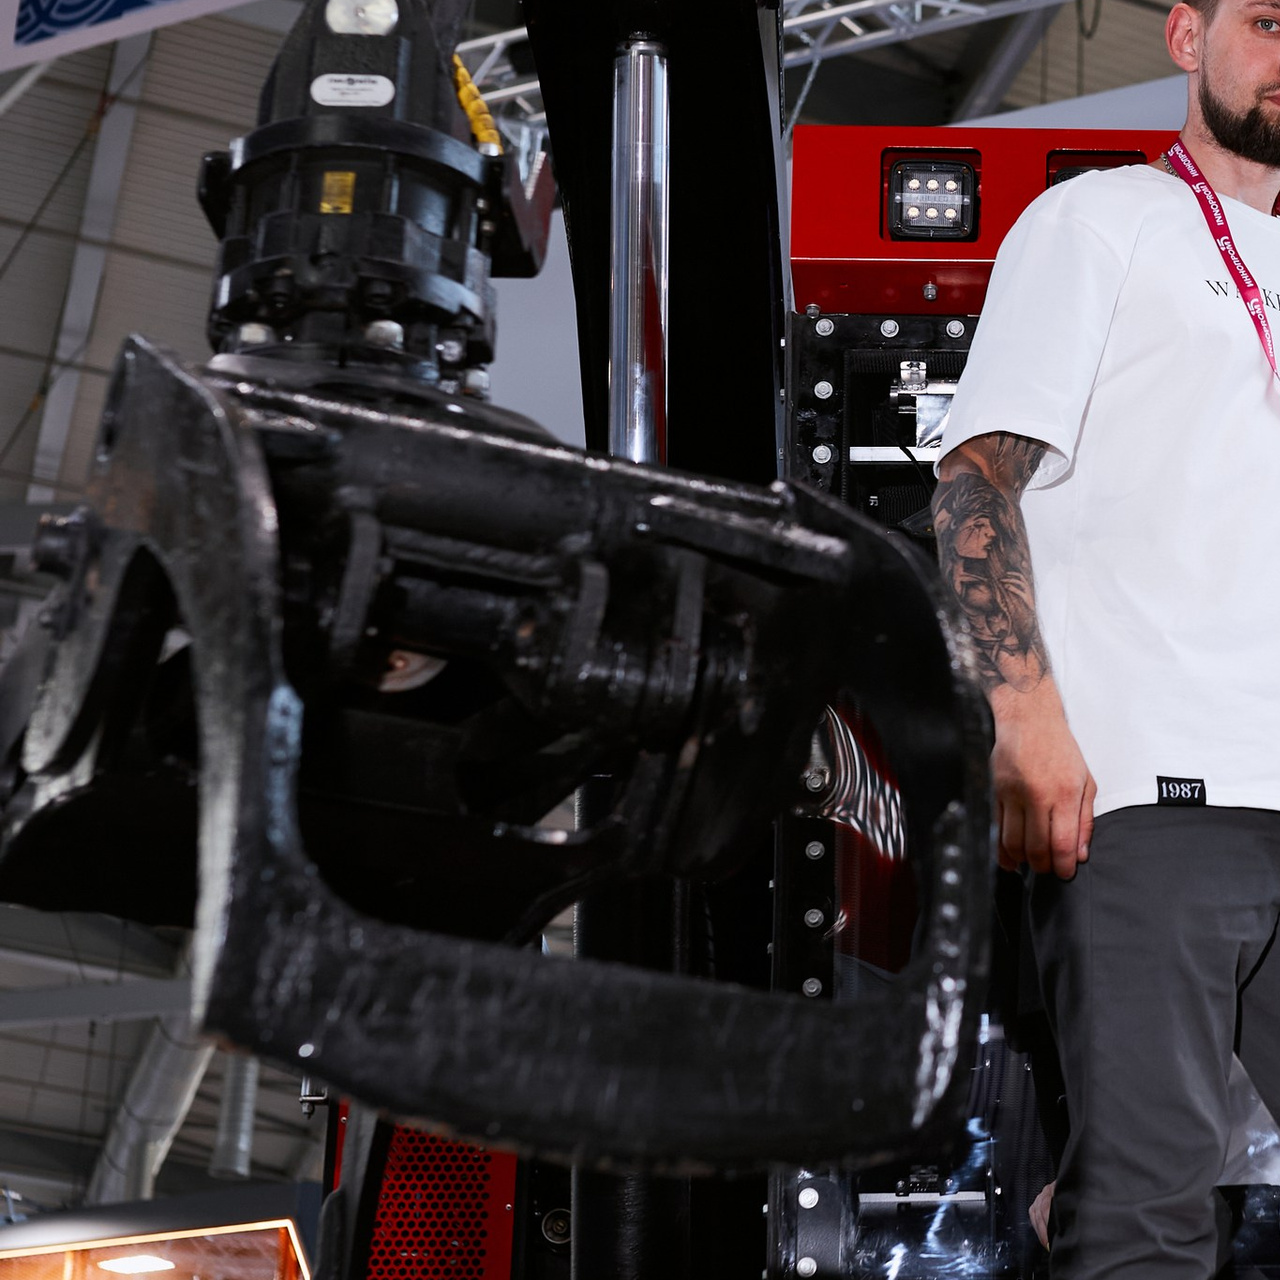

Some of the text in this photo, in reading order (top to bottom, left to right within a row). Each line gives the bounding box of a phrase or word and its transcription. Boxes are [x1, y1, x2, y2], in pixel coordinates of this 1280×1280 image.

[1200, 186, 1225, 226] INNOPROM
[1225, 240, 1255, 288] ИННОПРОМ
[1253, 303, 1275, 358] INNOPROM
[1160, 781, 1202, 799] 1987
